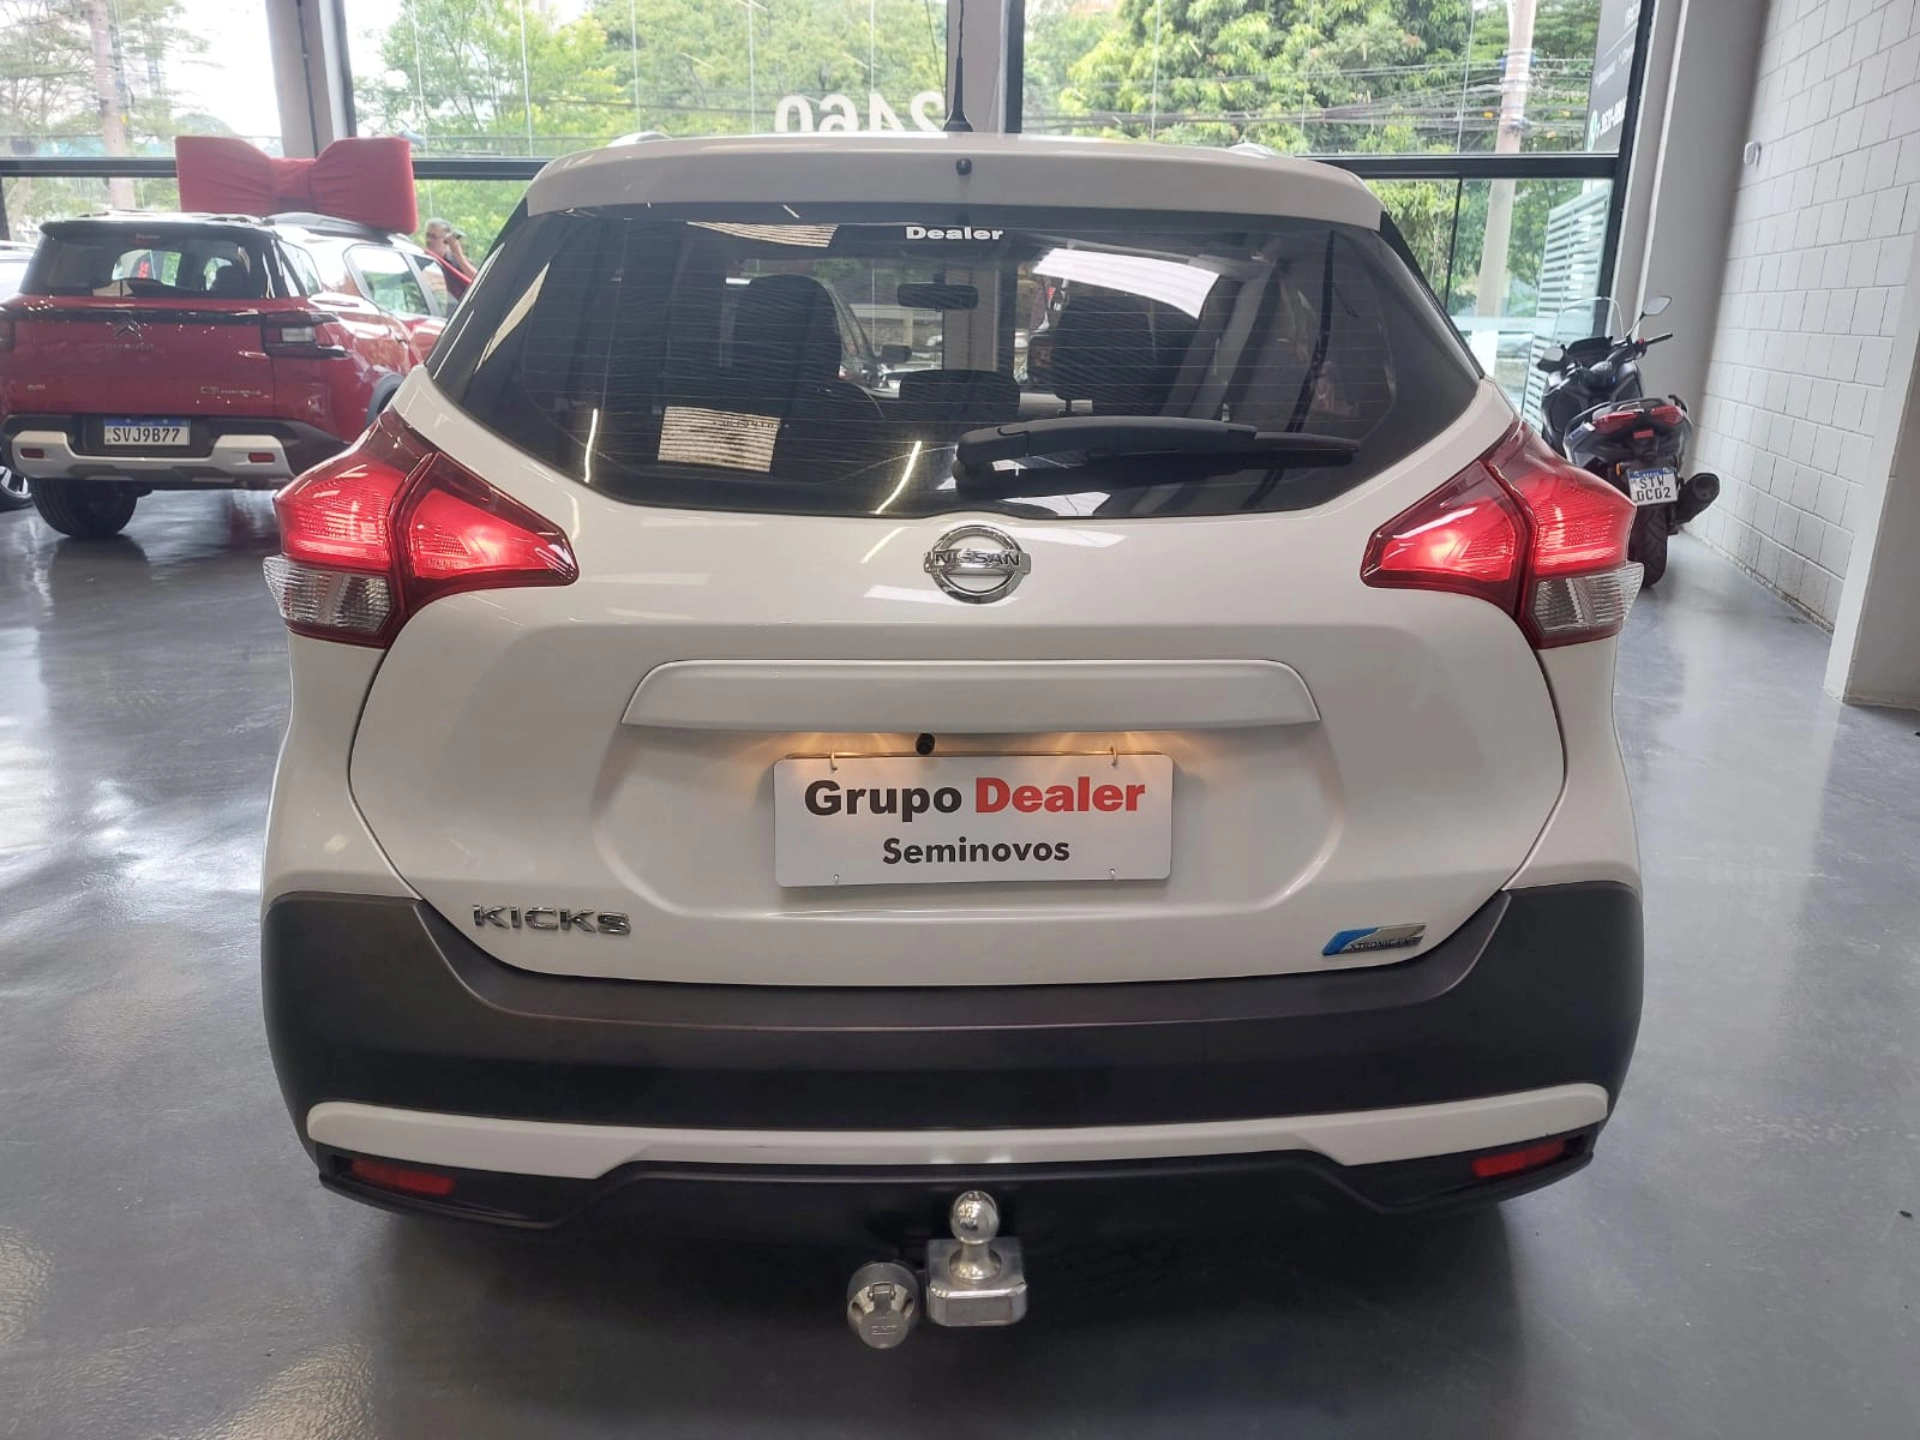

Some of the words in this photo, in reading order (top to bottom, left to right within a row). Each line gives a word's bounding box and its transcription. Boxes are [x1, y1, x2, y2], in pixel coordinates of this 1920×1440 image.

[906, 226, 1004, 240] Dealer
[112, 427, 180, 443] SVJ9B77
[935, 550, 1020, 566] NISSAN
[804, 780, 963, 823] Grupo
[974, 776, 1146, 814] Dealer
[883, 836, 1070, 865] Seminovos
[472, 904, 631, 935] KICKS
